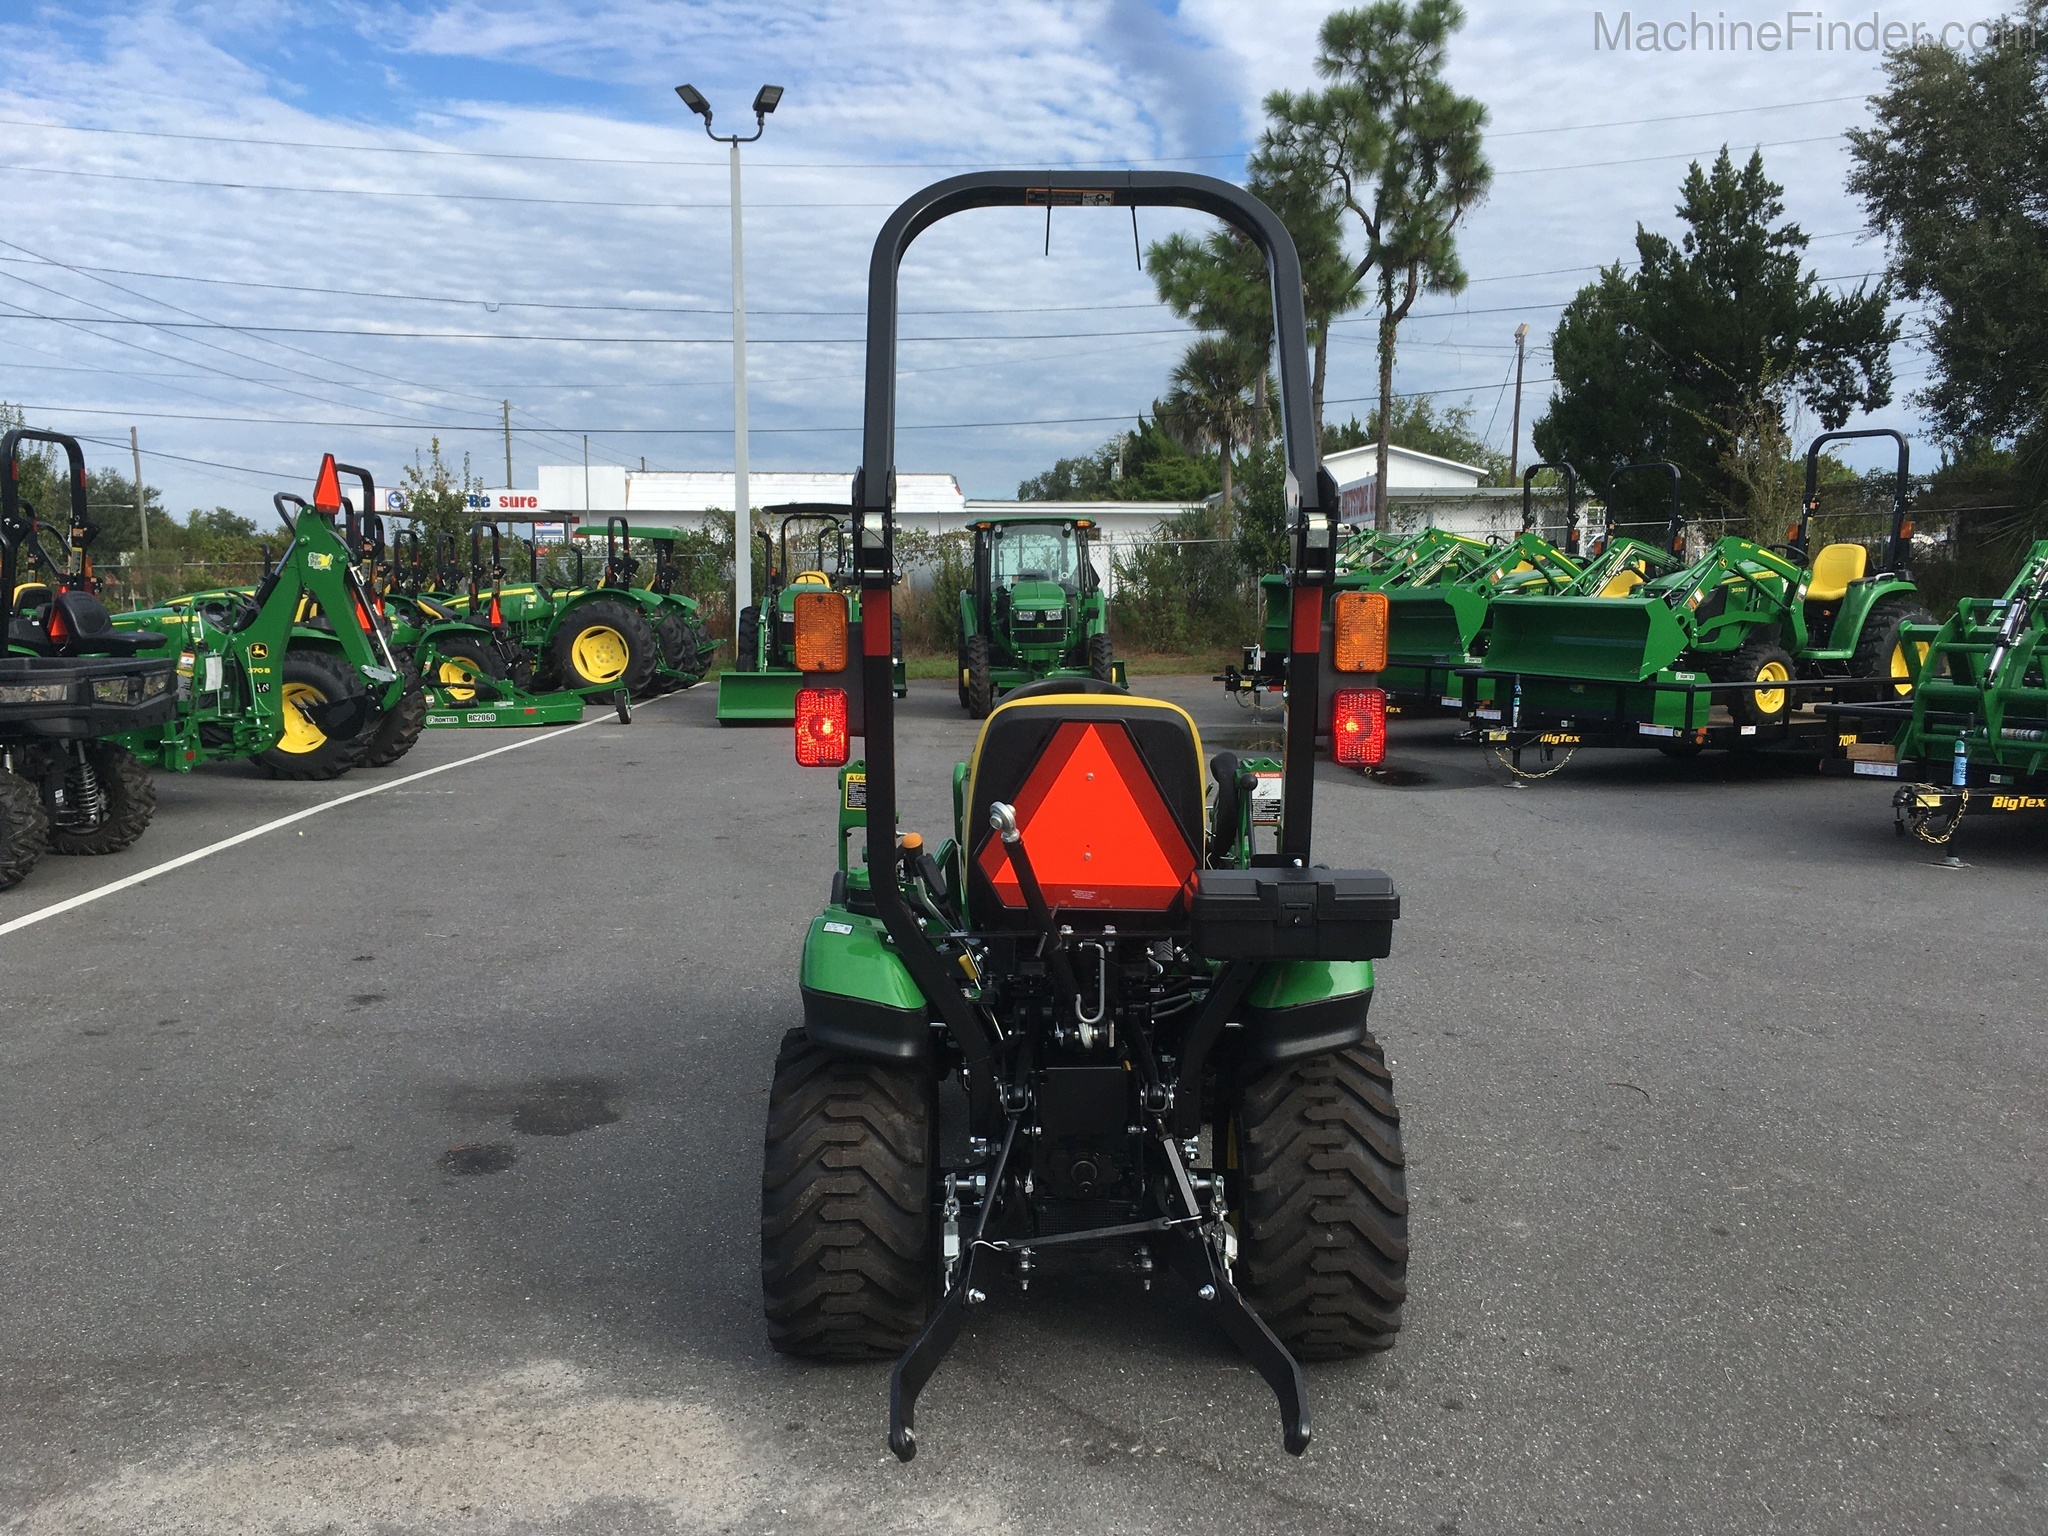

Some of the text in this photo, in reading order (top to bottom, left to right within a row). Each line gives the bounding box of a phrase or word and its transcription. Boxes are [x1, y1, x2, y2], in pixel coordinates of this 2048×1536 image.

[498, 495, 538, 508] sure
[468, 713, 496, 722] RC2060
[1991, 796, 2047, 811] BigTex
